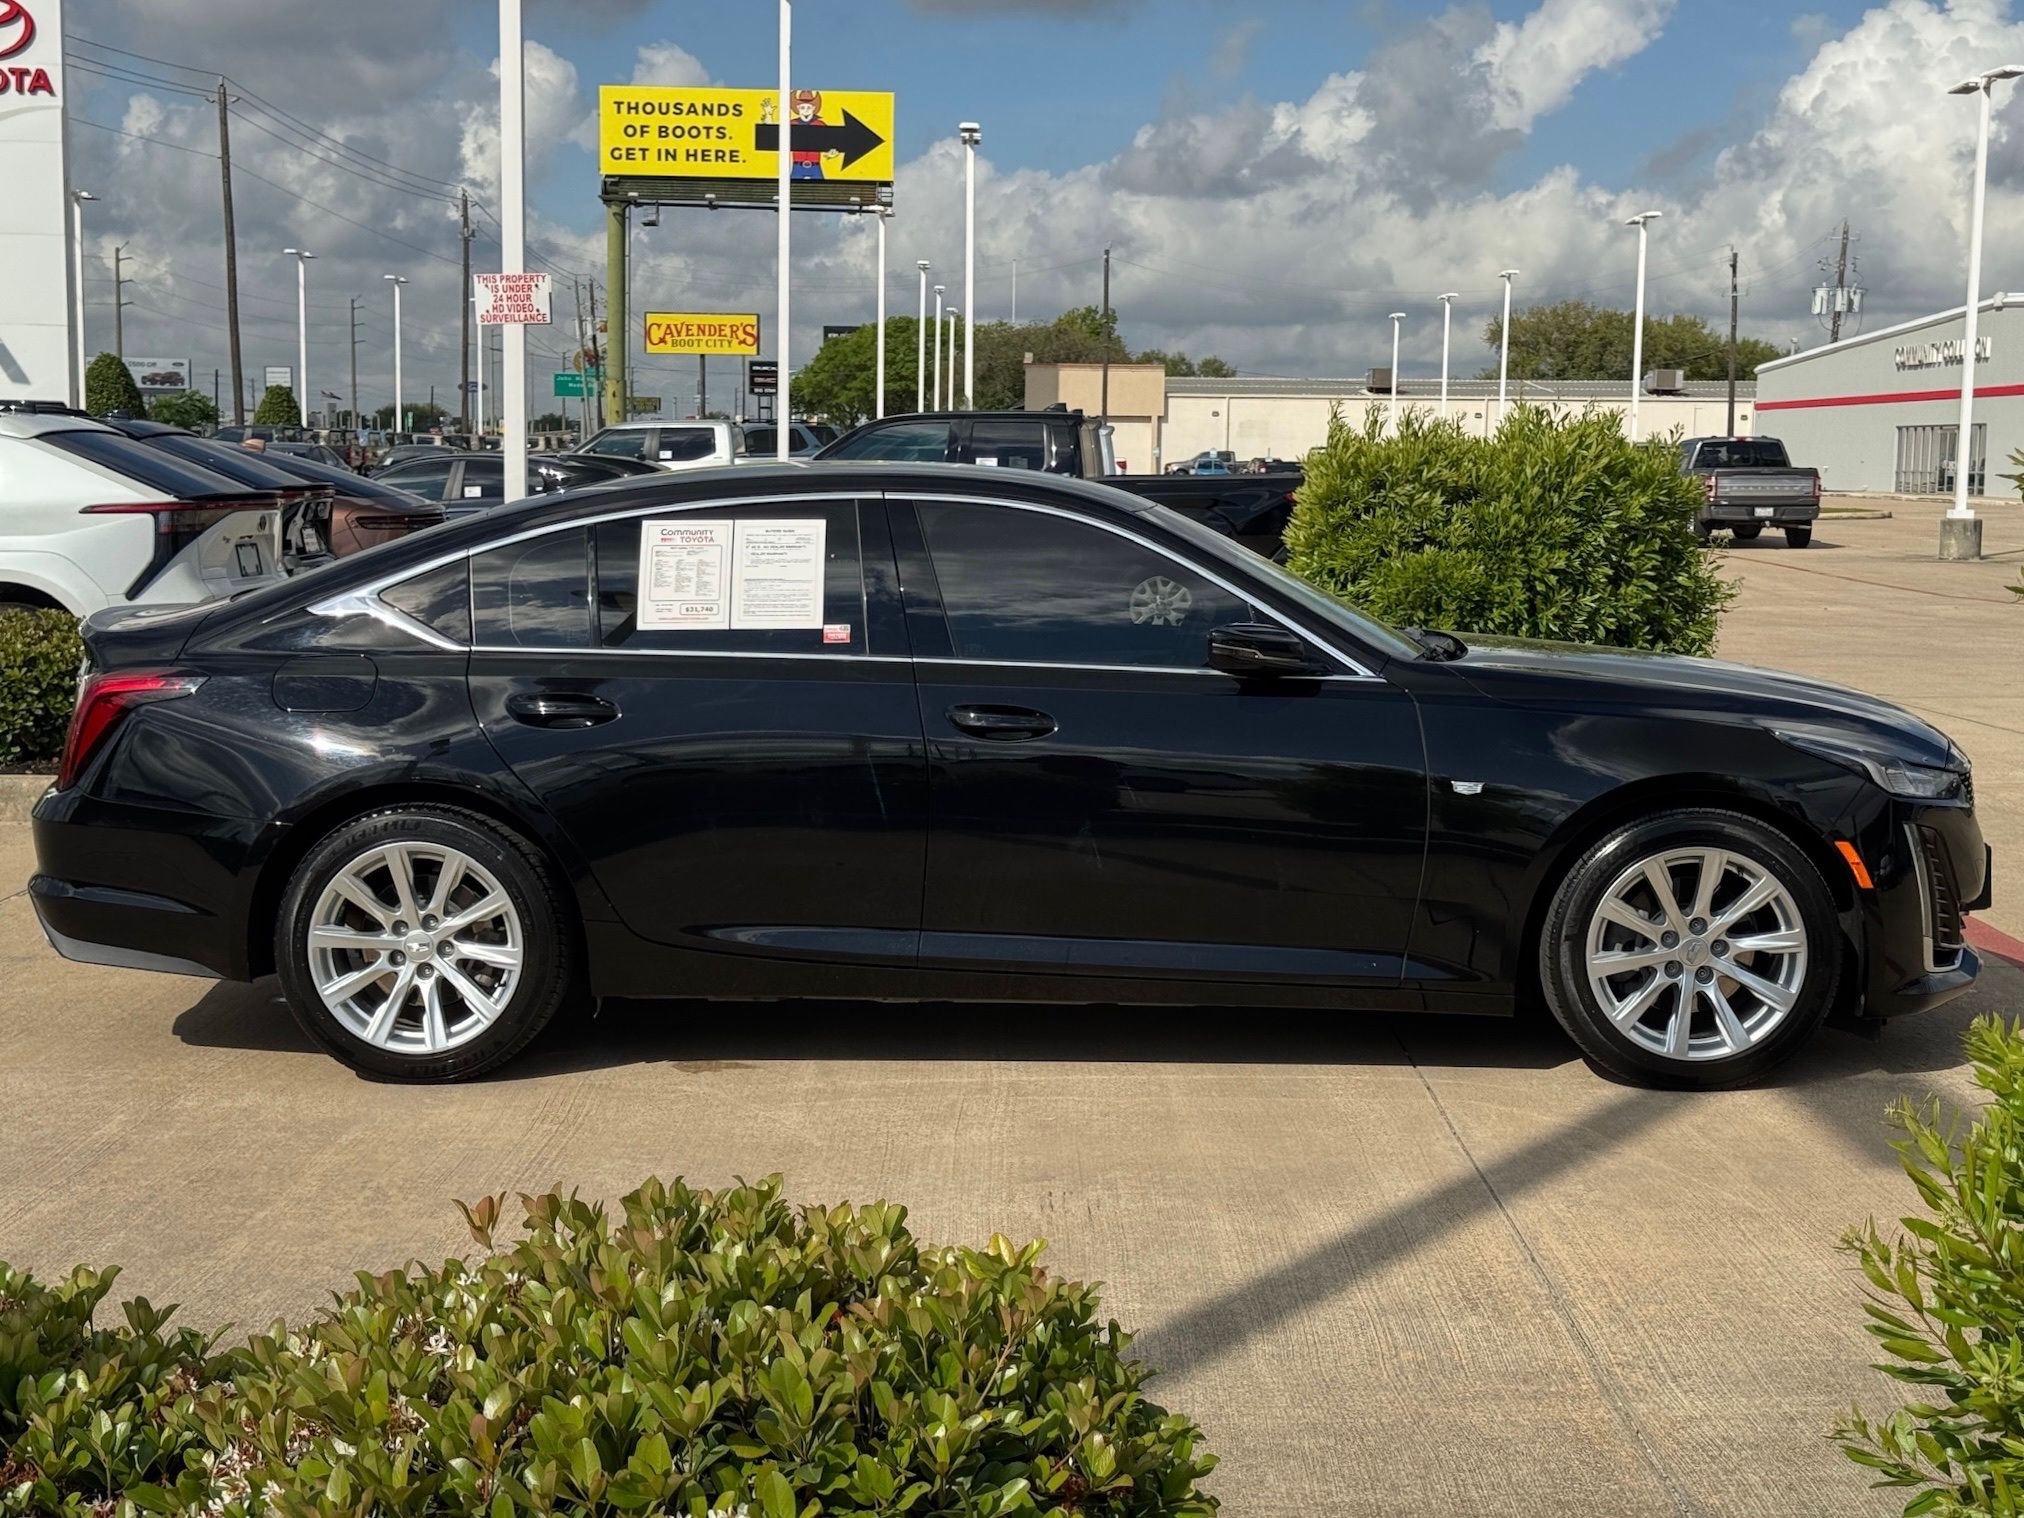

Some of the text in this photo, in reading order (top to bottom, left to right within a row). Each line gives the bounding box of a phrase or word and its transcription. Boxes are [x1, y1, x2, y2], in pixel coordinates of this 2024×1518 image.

[613, 100, 743, 117] THOUSANDS
[623, 124, 733, 140] OF BOOTS.
[610, 147, 747, 164] GET IN HERE.
[476, 274, 547, 284] THIS PROPERTY
[491, 284, 533, 293] IS UNDER
[493, 294, 532, 303] 24 HOUR
[492, 303, 534, 313] HD VIDEO
[480, 313, 548, 323] SURVEILLANCE
[647, 321, 758, 347] CAVENDER'S
[671, 339, 734, 348] BOOT CITY
